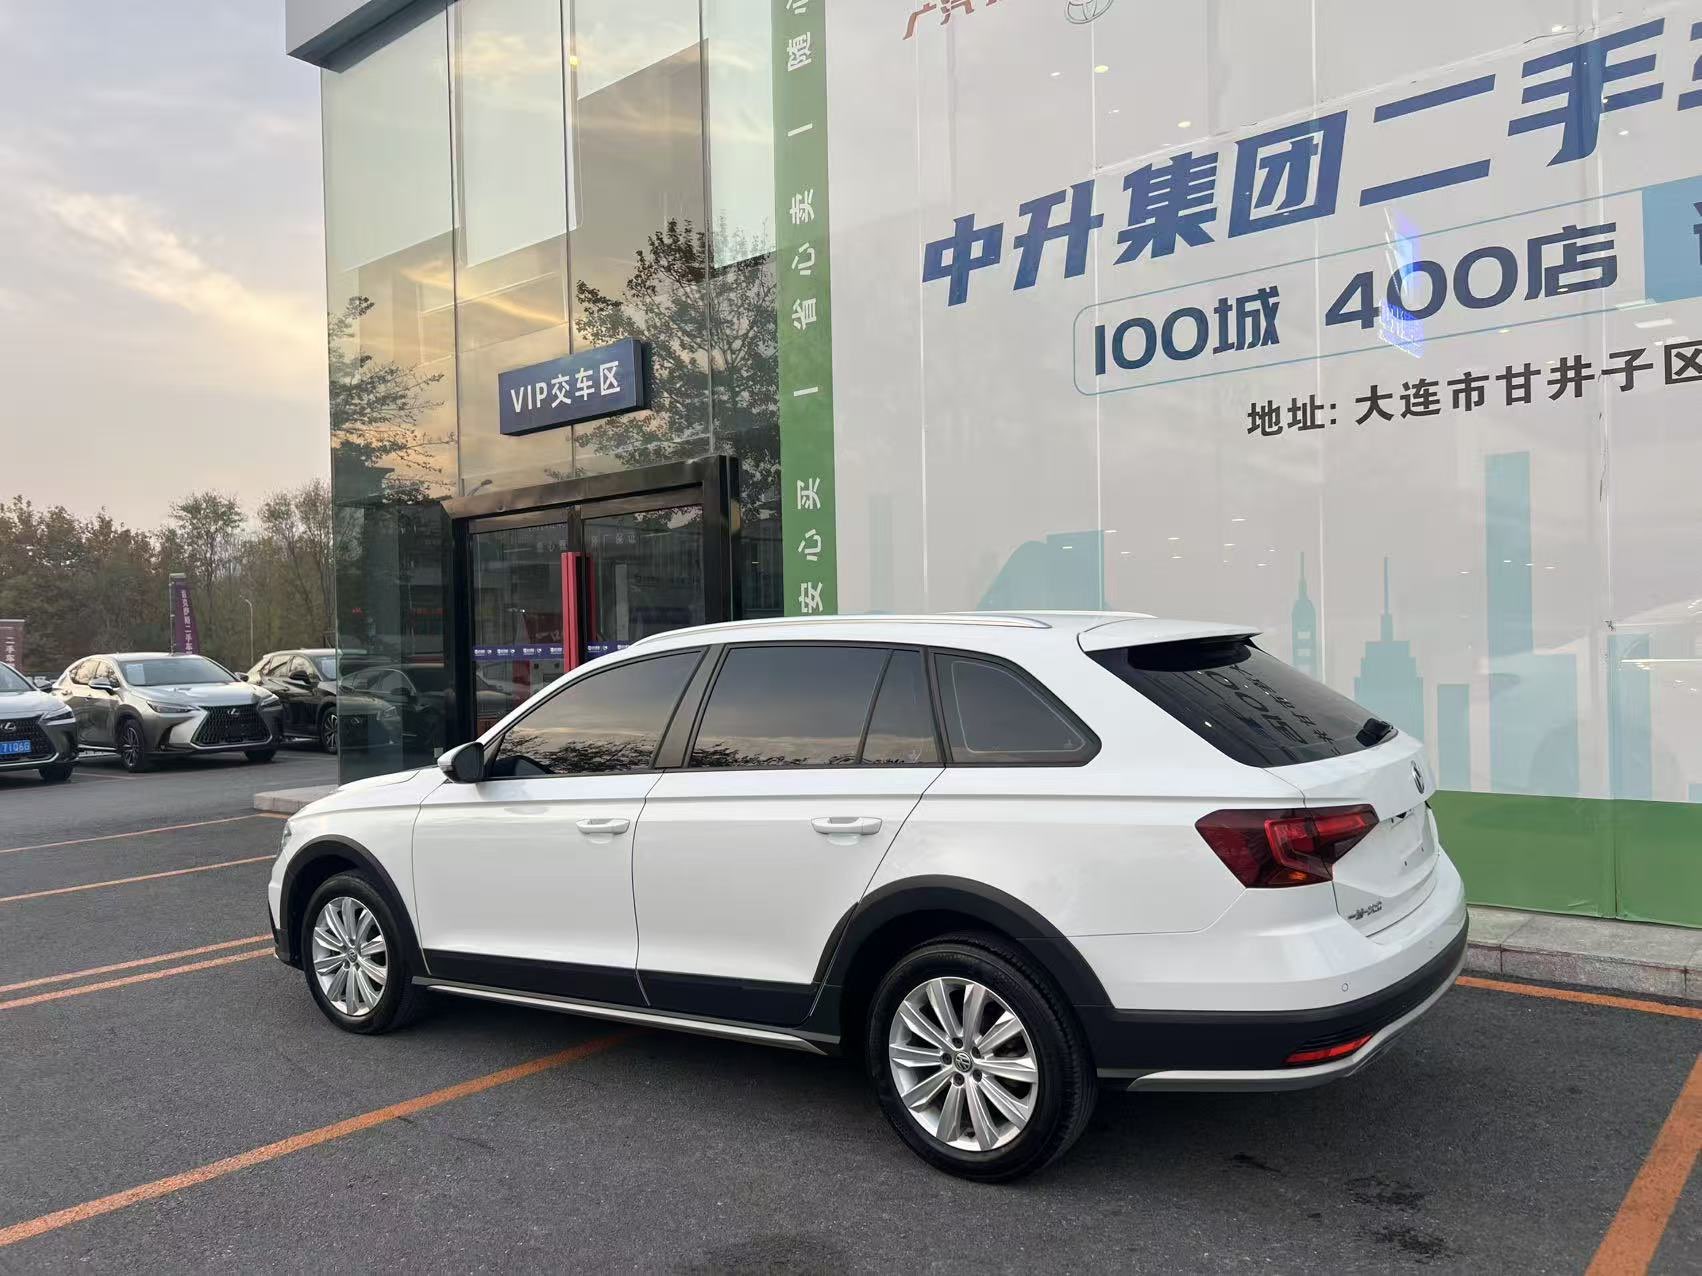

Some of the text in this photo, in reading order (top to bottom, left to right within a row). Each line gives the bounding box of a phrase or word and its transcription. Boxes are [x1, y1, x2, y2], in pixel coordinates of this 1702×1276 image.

[902, 0, 999, 40] 广汽
[922, 17, 1702, 307] 中升集团二手
[789, 189, 817, 330] 省心卖
[1094, 285, 1280, 376] 100城
[1325, 222, 1618, 331] 400店
[510, 360, 621, 413] VIP交车区
[796, 477, 823, 613] 安心买
